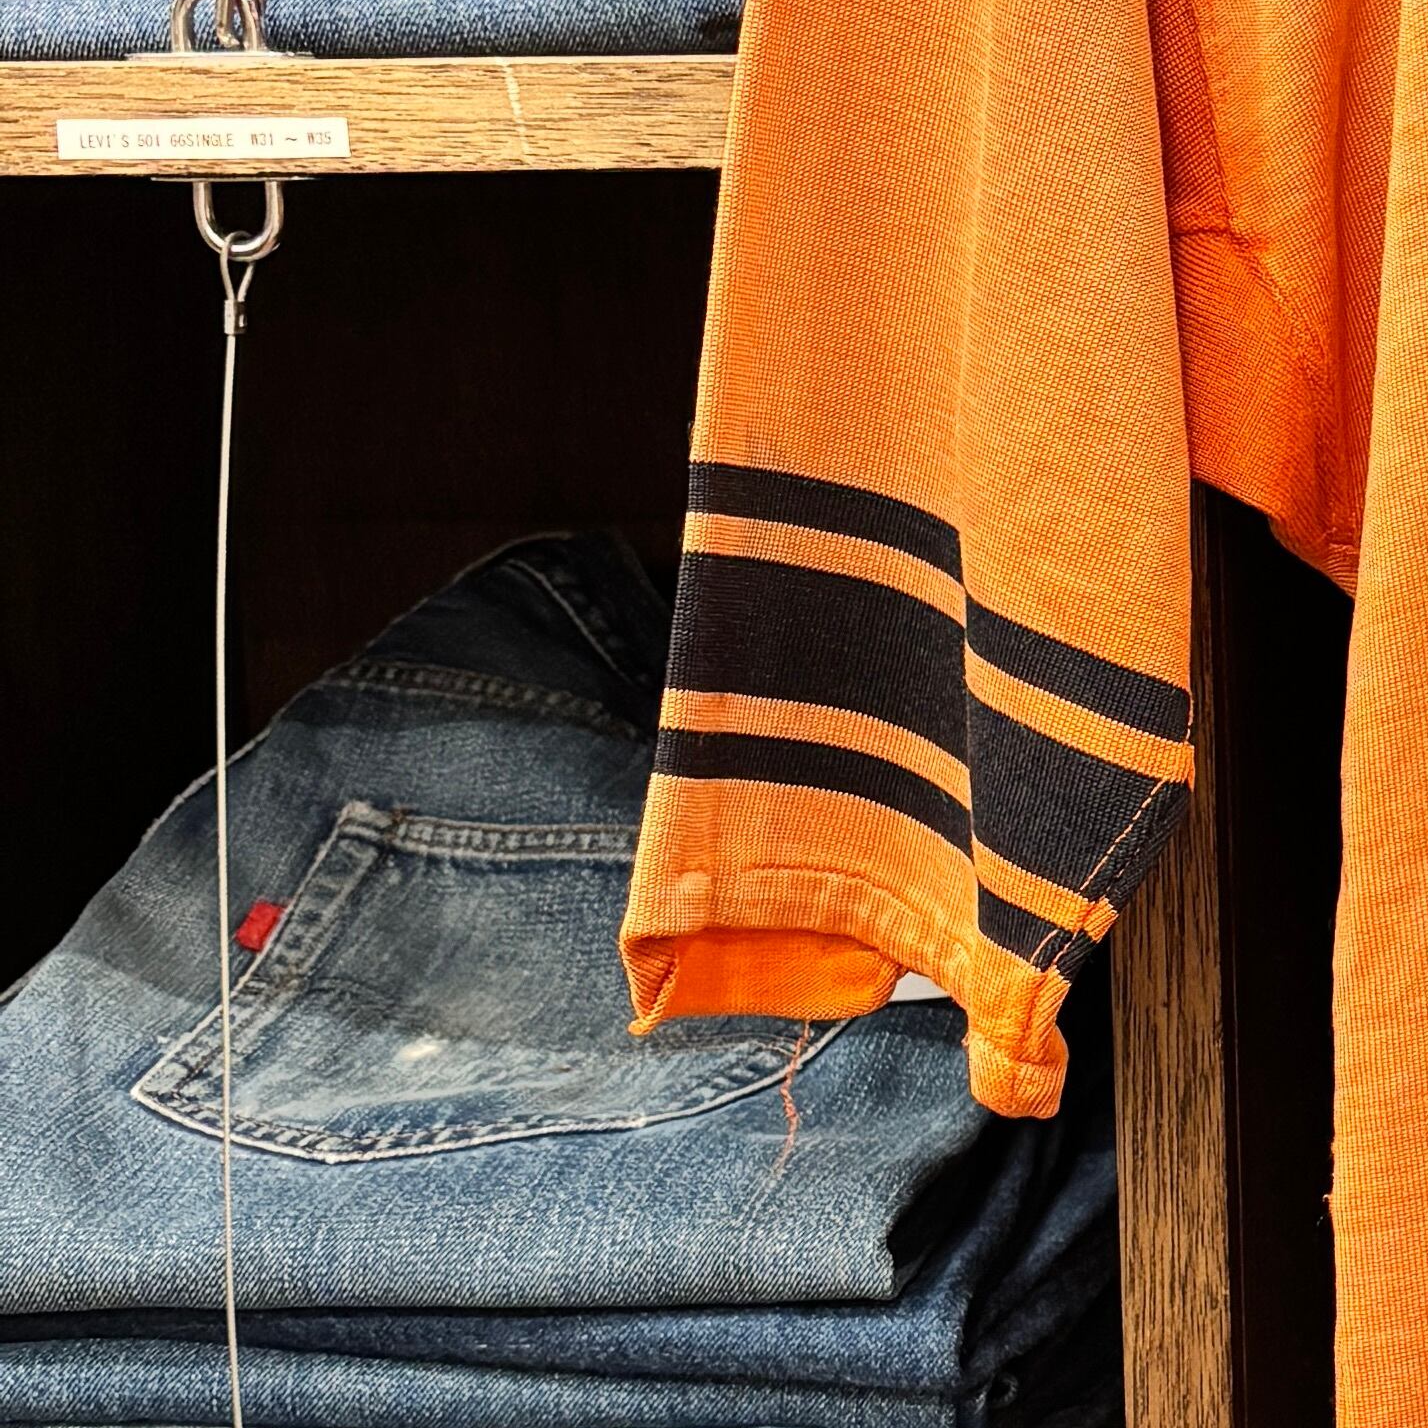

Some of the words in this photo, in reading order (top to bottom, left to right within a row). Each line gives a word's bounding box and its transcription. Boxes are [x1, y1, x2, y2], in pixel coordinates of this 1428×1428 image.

[79, 133, 130, 149] LEVI'S
[137, 132, 161, 148] 501
[250, 131, 275, 147] W31
[307, 130, 332, 146] W35
